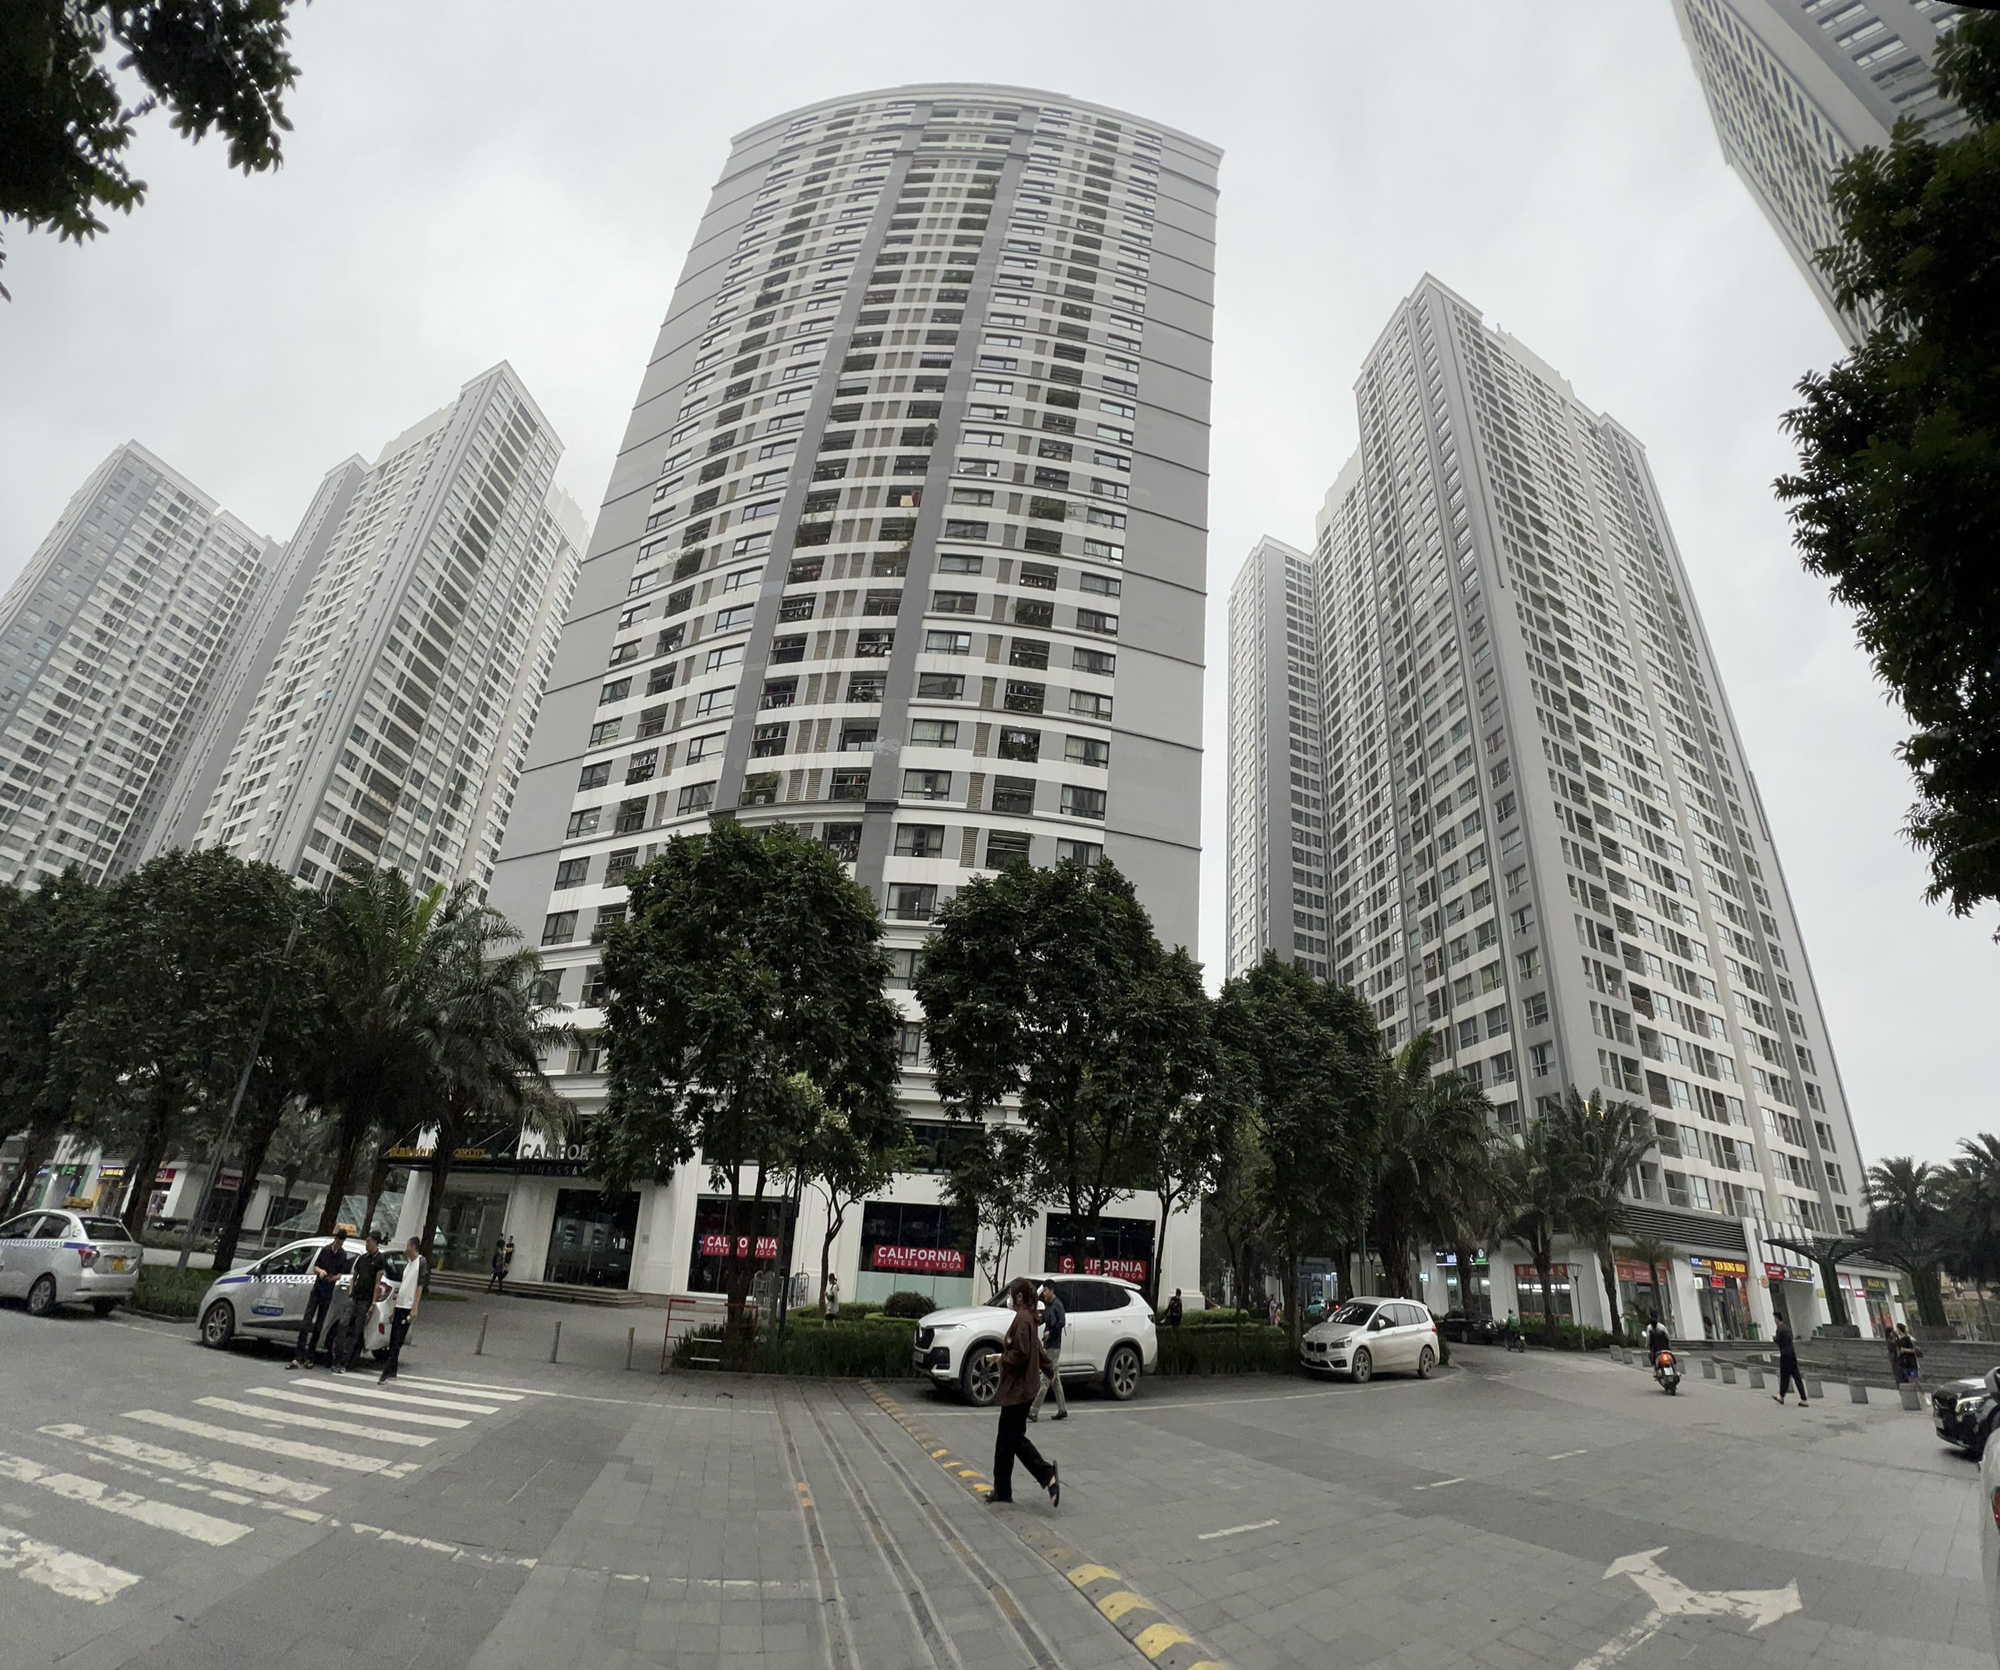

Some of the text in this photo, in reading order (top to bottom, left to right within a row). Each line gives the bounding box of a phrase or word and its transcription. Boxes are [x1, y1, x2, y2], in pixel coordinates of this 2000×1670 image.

[878, 1247, 962, 1262] CALIFORNIA
[877, 1258, 918, 1267] FITNESS
[1063, 1258, 1143, 1273] CIFORNIA
